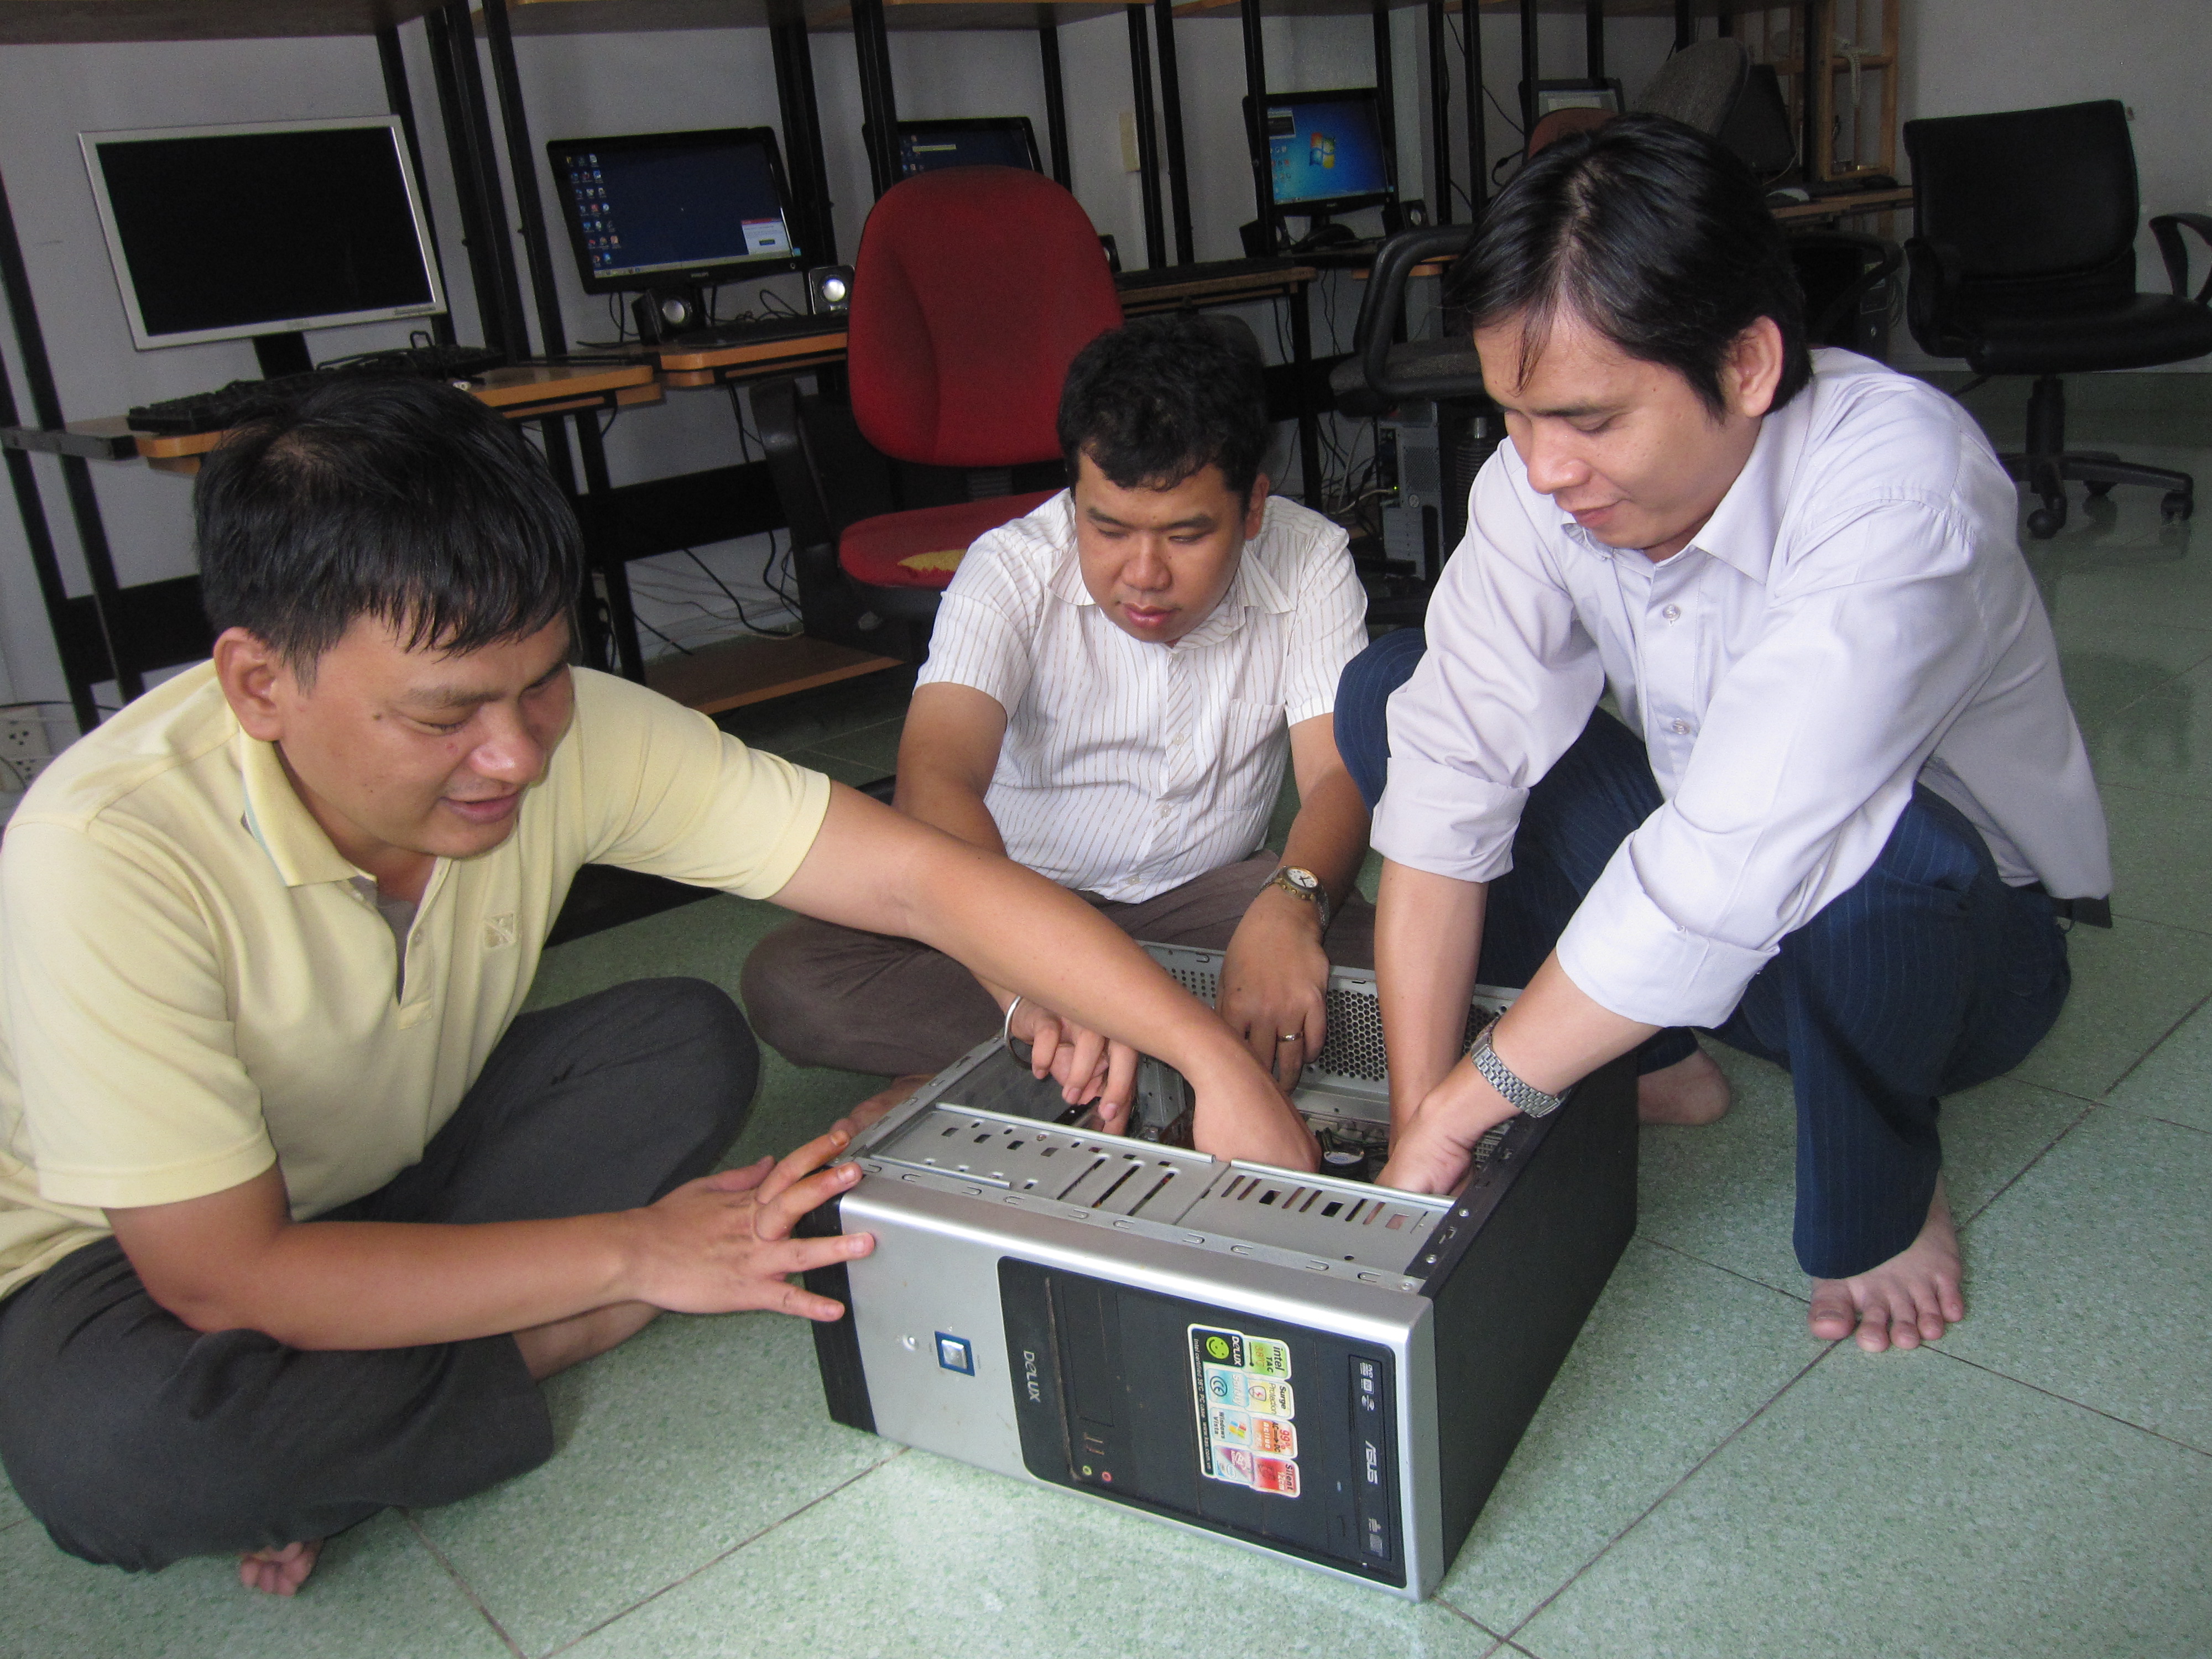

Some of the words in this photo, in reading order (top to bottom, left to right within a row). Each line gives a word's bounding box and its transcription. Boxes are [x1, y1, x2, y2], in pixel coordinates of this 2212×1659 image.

[1273, 1347, 1285, 1371] intel
[1199, 1394, 1206, 1403] PC
[1232, 1374, 1243, 1405] Safety
[1268, 1383, 1277, 1415] Protection
[1272, 1422, 1279, 1430] AC
[1274, 1444, 1281, 1453] DC
[1280, 1430, 1291, 1449] 99%
[1364, 1440, 1379, 1484] ASUS
[1285, 1464, 1293, 1490] Silent
